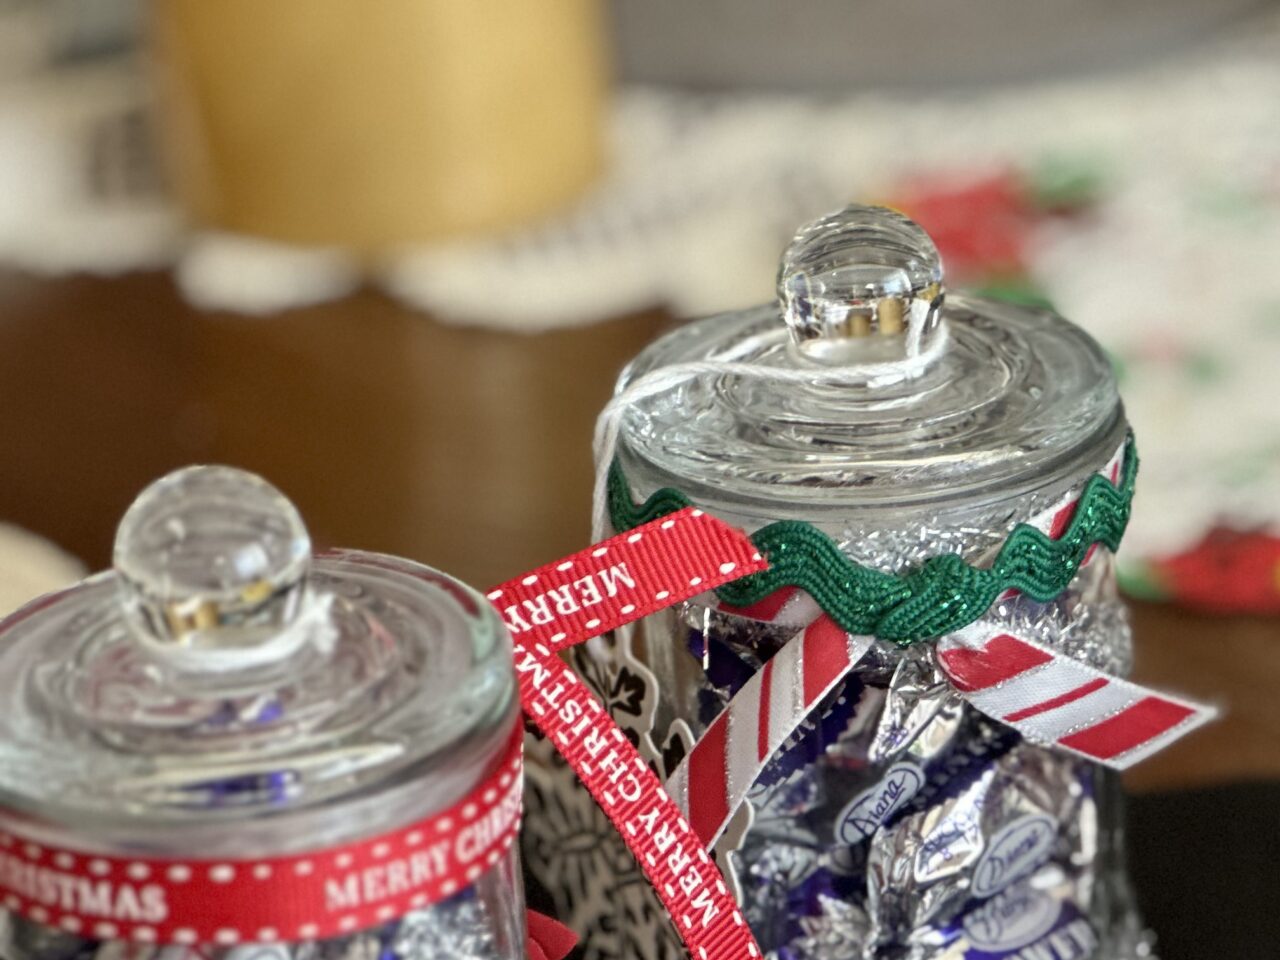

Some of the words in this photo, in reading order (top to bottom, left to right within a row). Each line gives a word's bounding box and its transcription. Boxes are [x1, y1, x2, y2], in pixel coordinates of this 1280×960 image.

[504, 562, 636, 633] MERRY
[847, 774, 906, 836] Diana
[325, 838, 450, 912] MERRY
[637, 807, 720, 928] MERRY
